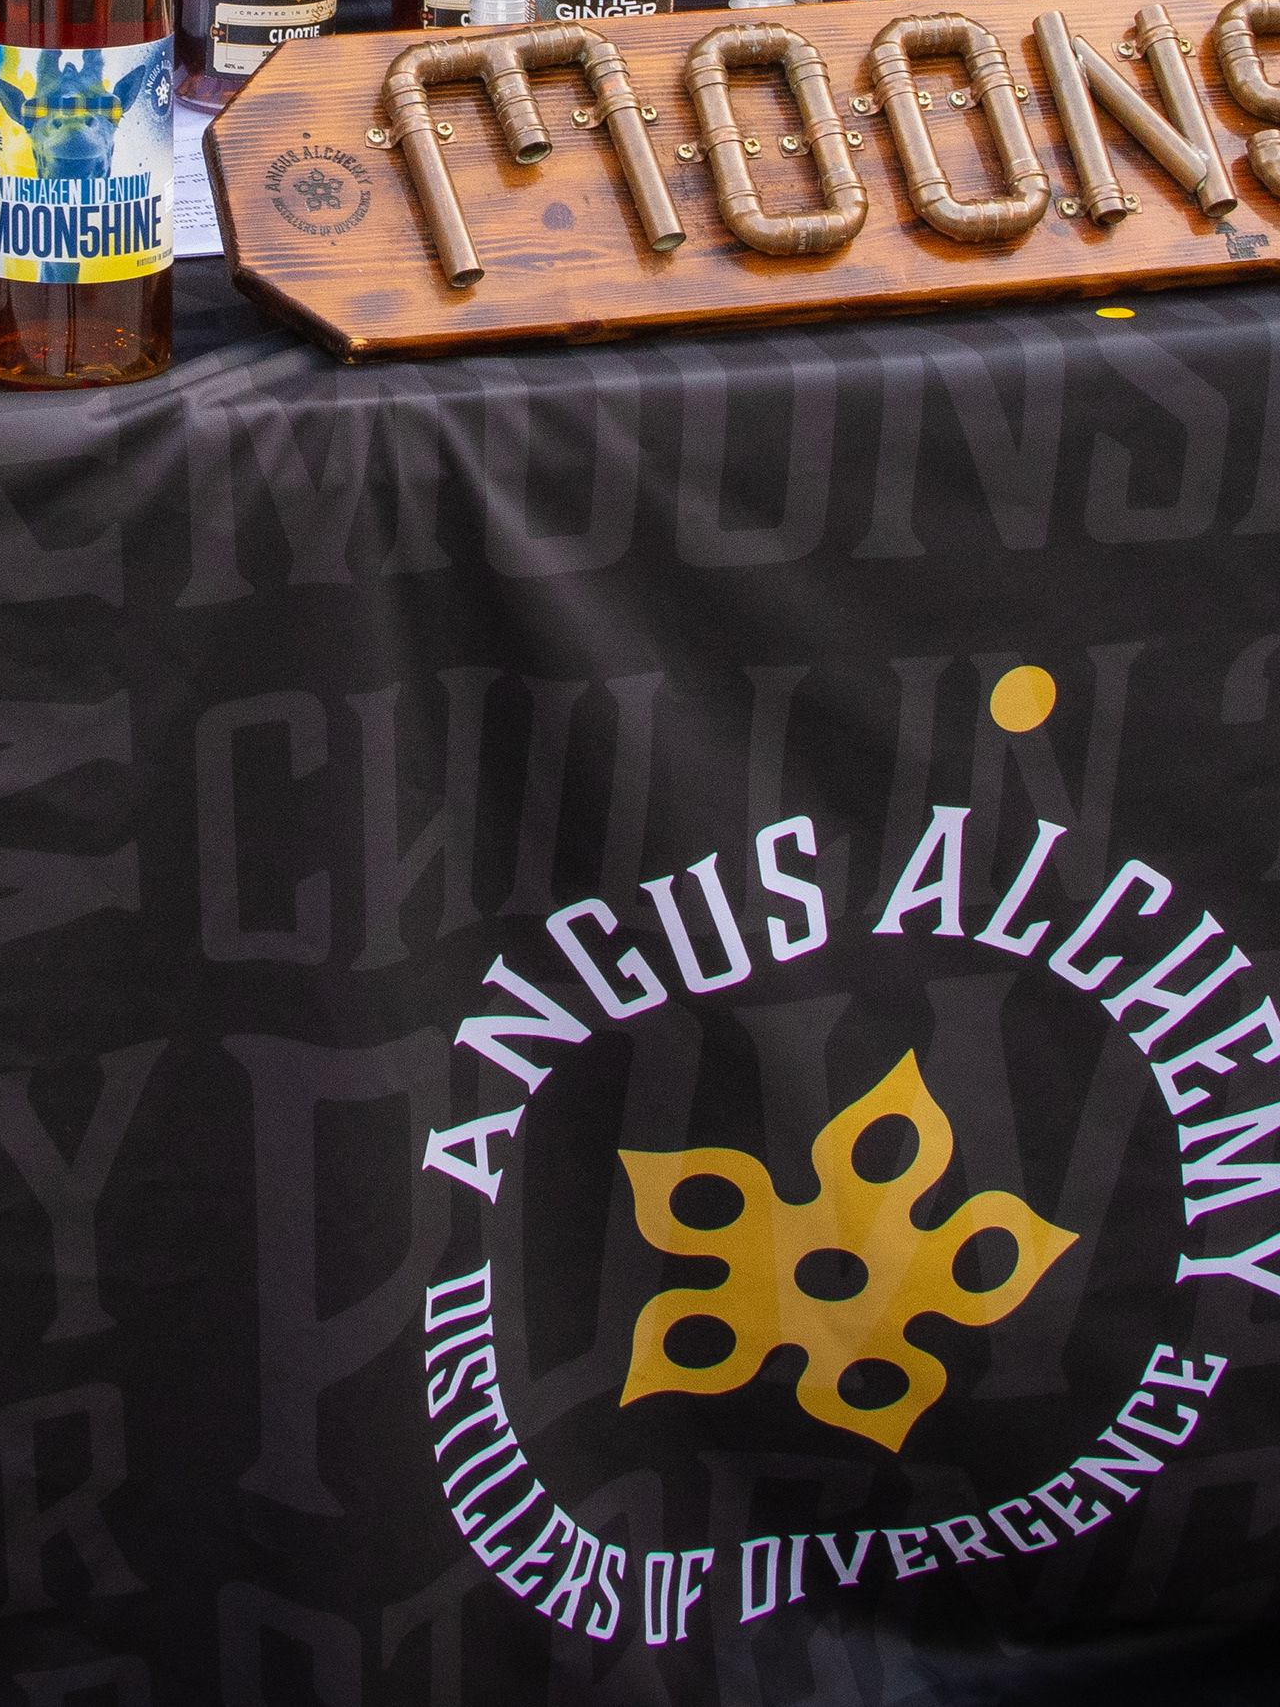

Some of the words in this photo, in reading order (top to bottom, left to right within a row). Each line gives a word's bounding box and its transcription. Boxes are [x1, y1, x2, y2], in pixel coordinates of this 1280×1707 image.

[555, 2, 658, 20] GINGER
[265, 150, 300, 192] ANGUS
[302, 145, 373, 185] ALCHEMY
[422, 815, 828, 1204] ANGUS
[424, 1258, 626, 1641] DISTILLERS
[643, 1547, 716, 1644] OF
[739, 1344, 1228, 1622] DIVERGENCE
